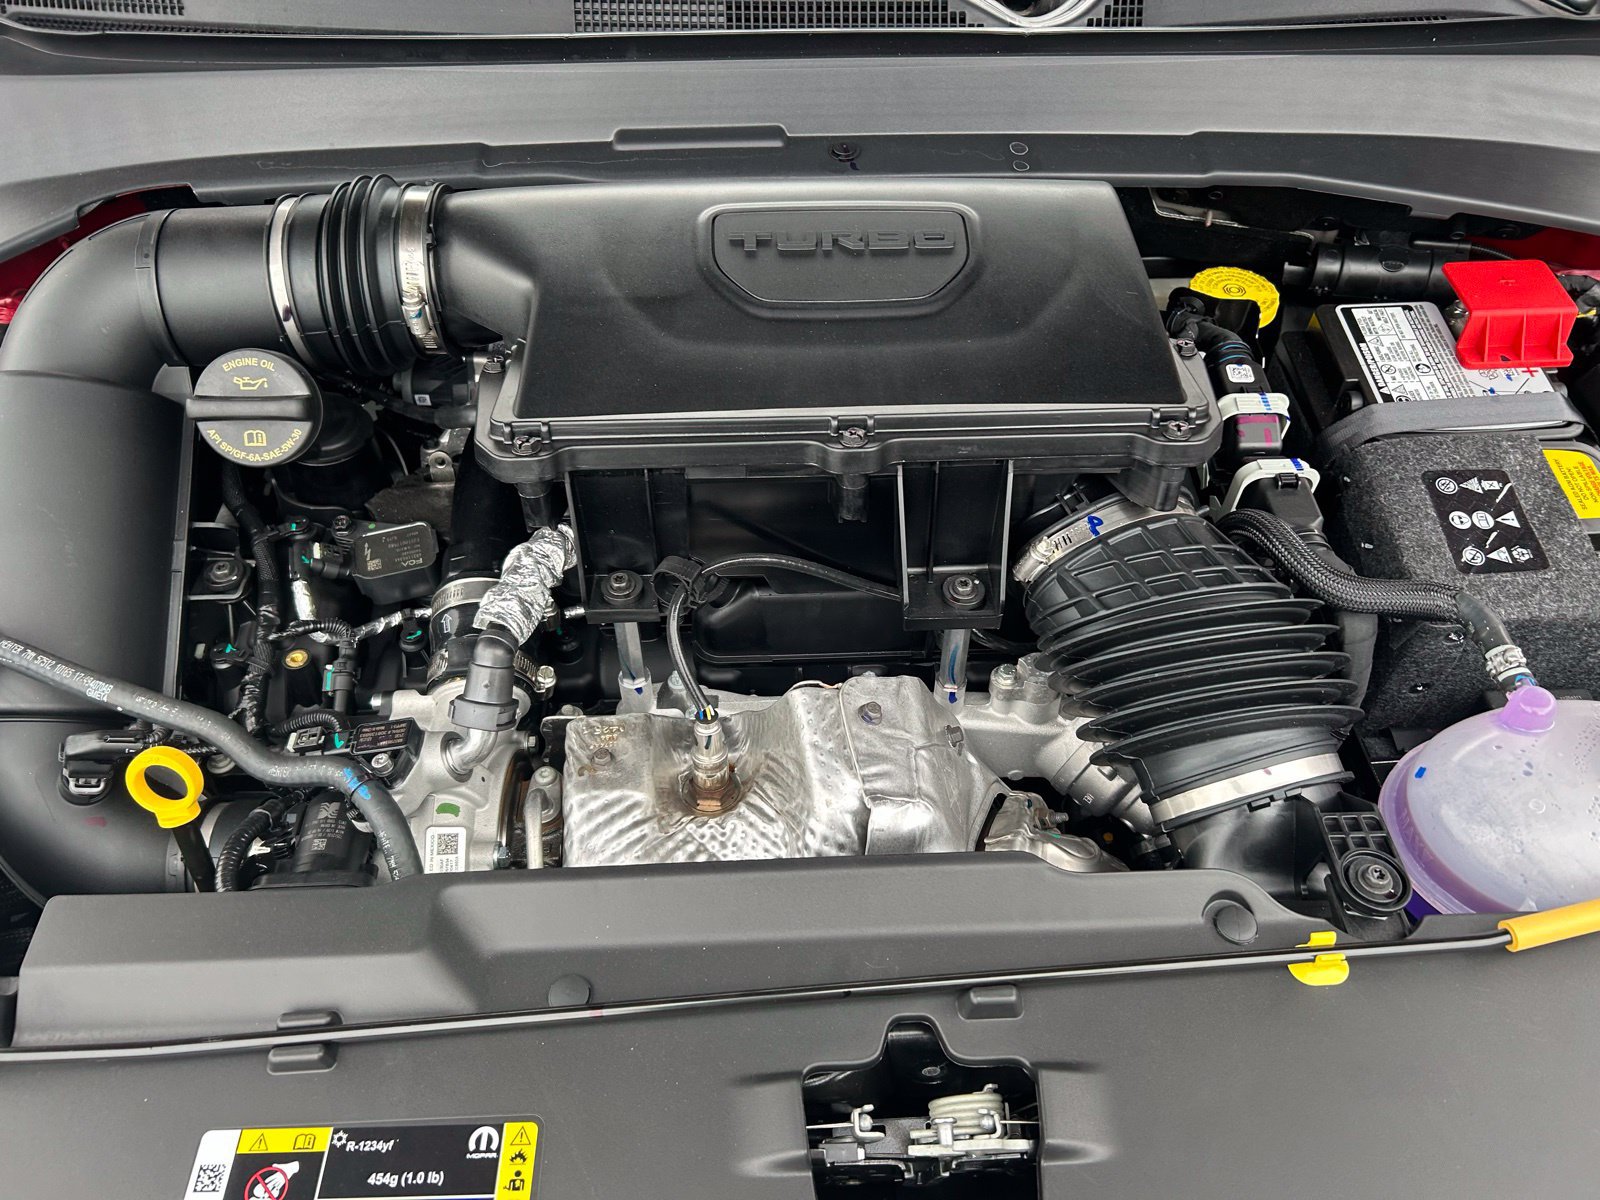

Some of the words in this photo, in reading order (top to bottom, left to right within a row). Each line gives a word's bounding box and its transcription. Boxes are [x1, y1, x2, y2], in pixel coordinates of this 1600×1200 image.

[728, 231, 956, 251] TURBO
[222, 357, 258, 372] ENGINE
[260, 359, 276, 372] OIL
[207, 429, 221, 445] API
[402, 558, 423, 567] FCA
[367, 1172, 399, 1188] 454g
[401, 1171, 425, 1188] (1.0
[427, 1170, 445, 1187] lb)
